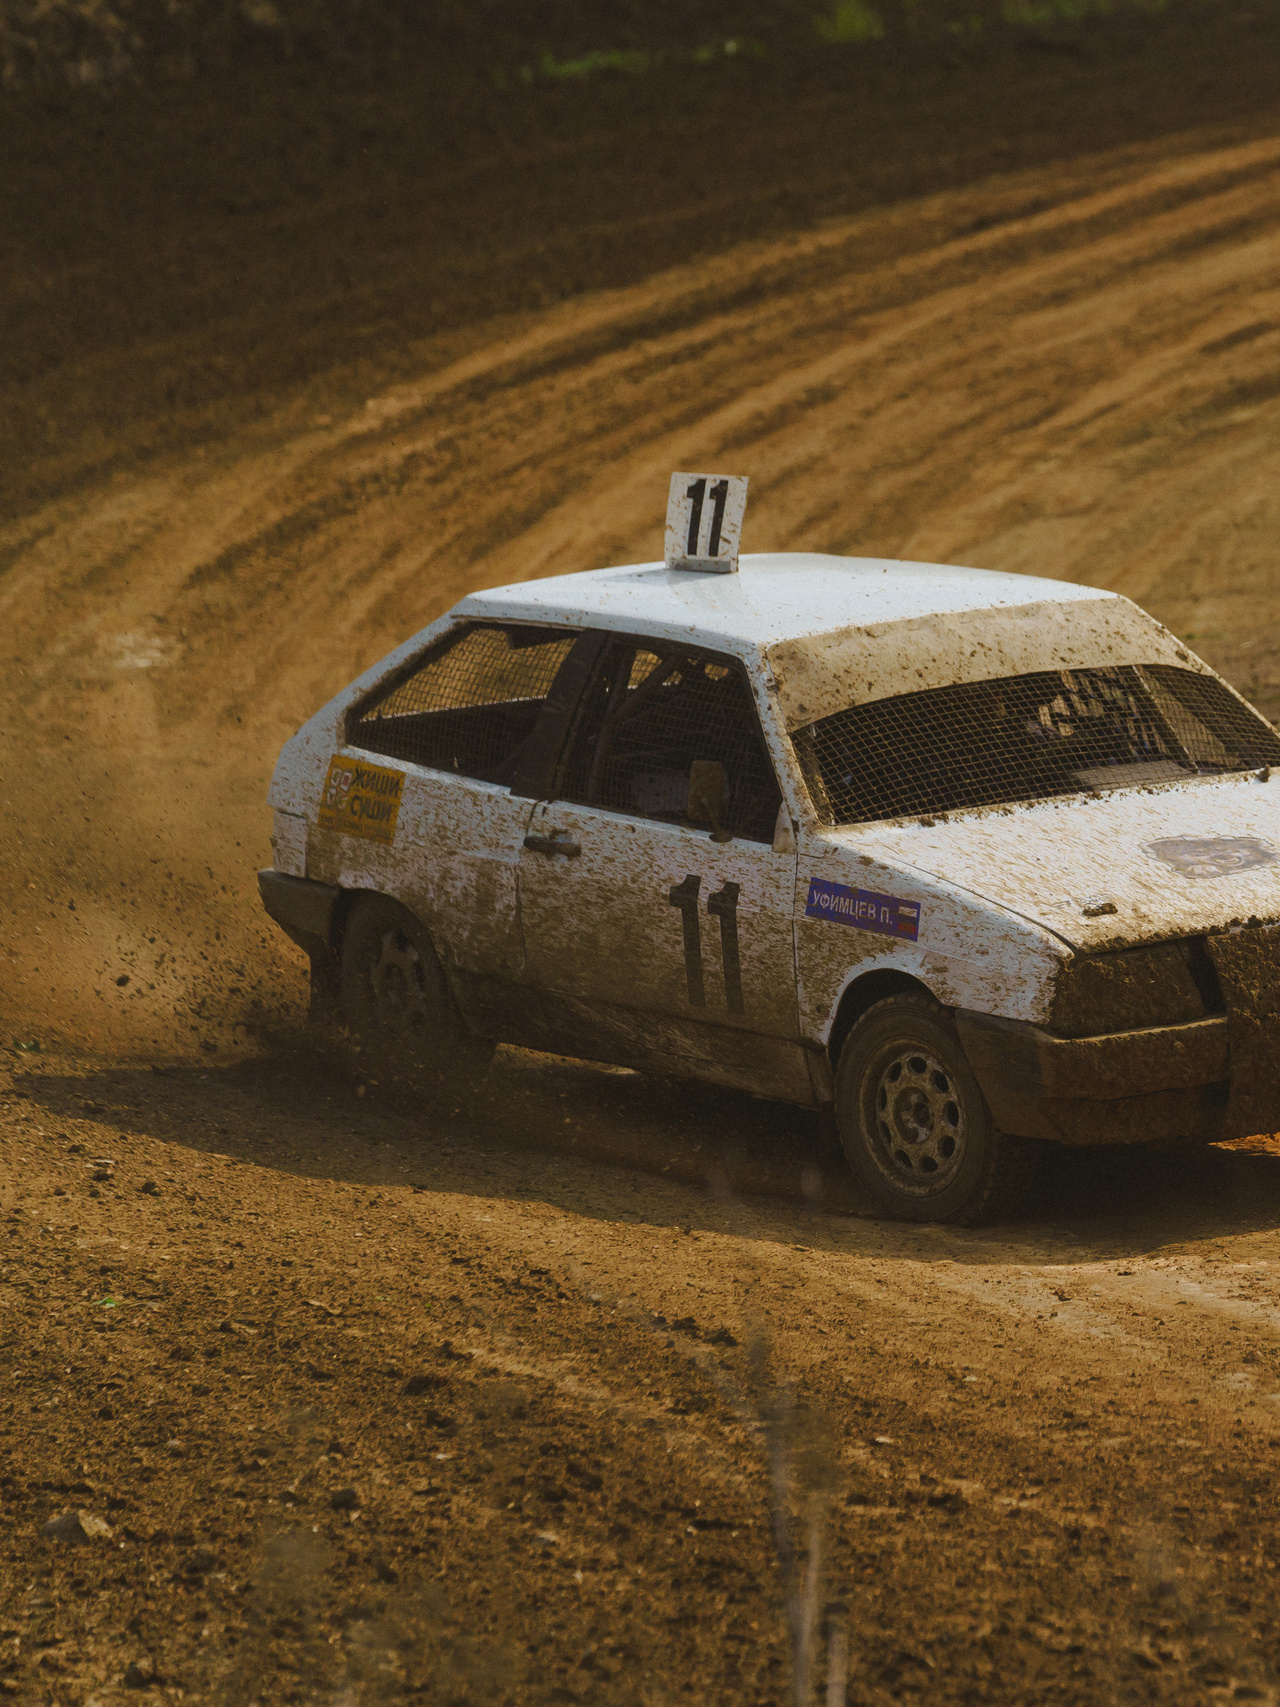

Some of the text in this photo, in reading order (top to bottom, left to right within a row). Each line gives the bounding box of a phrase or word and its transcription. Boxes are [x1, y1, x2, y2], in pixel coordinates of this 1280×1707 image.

[687, 478, 729, 557] 11
[669, 874, 746, 1015] 11
[812, 889, 893, 925] УФИМЦЕВ П.
